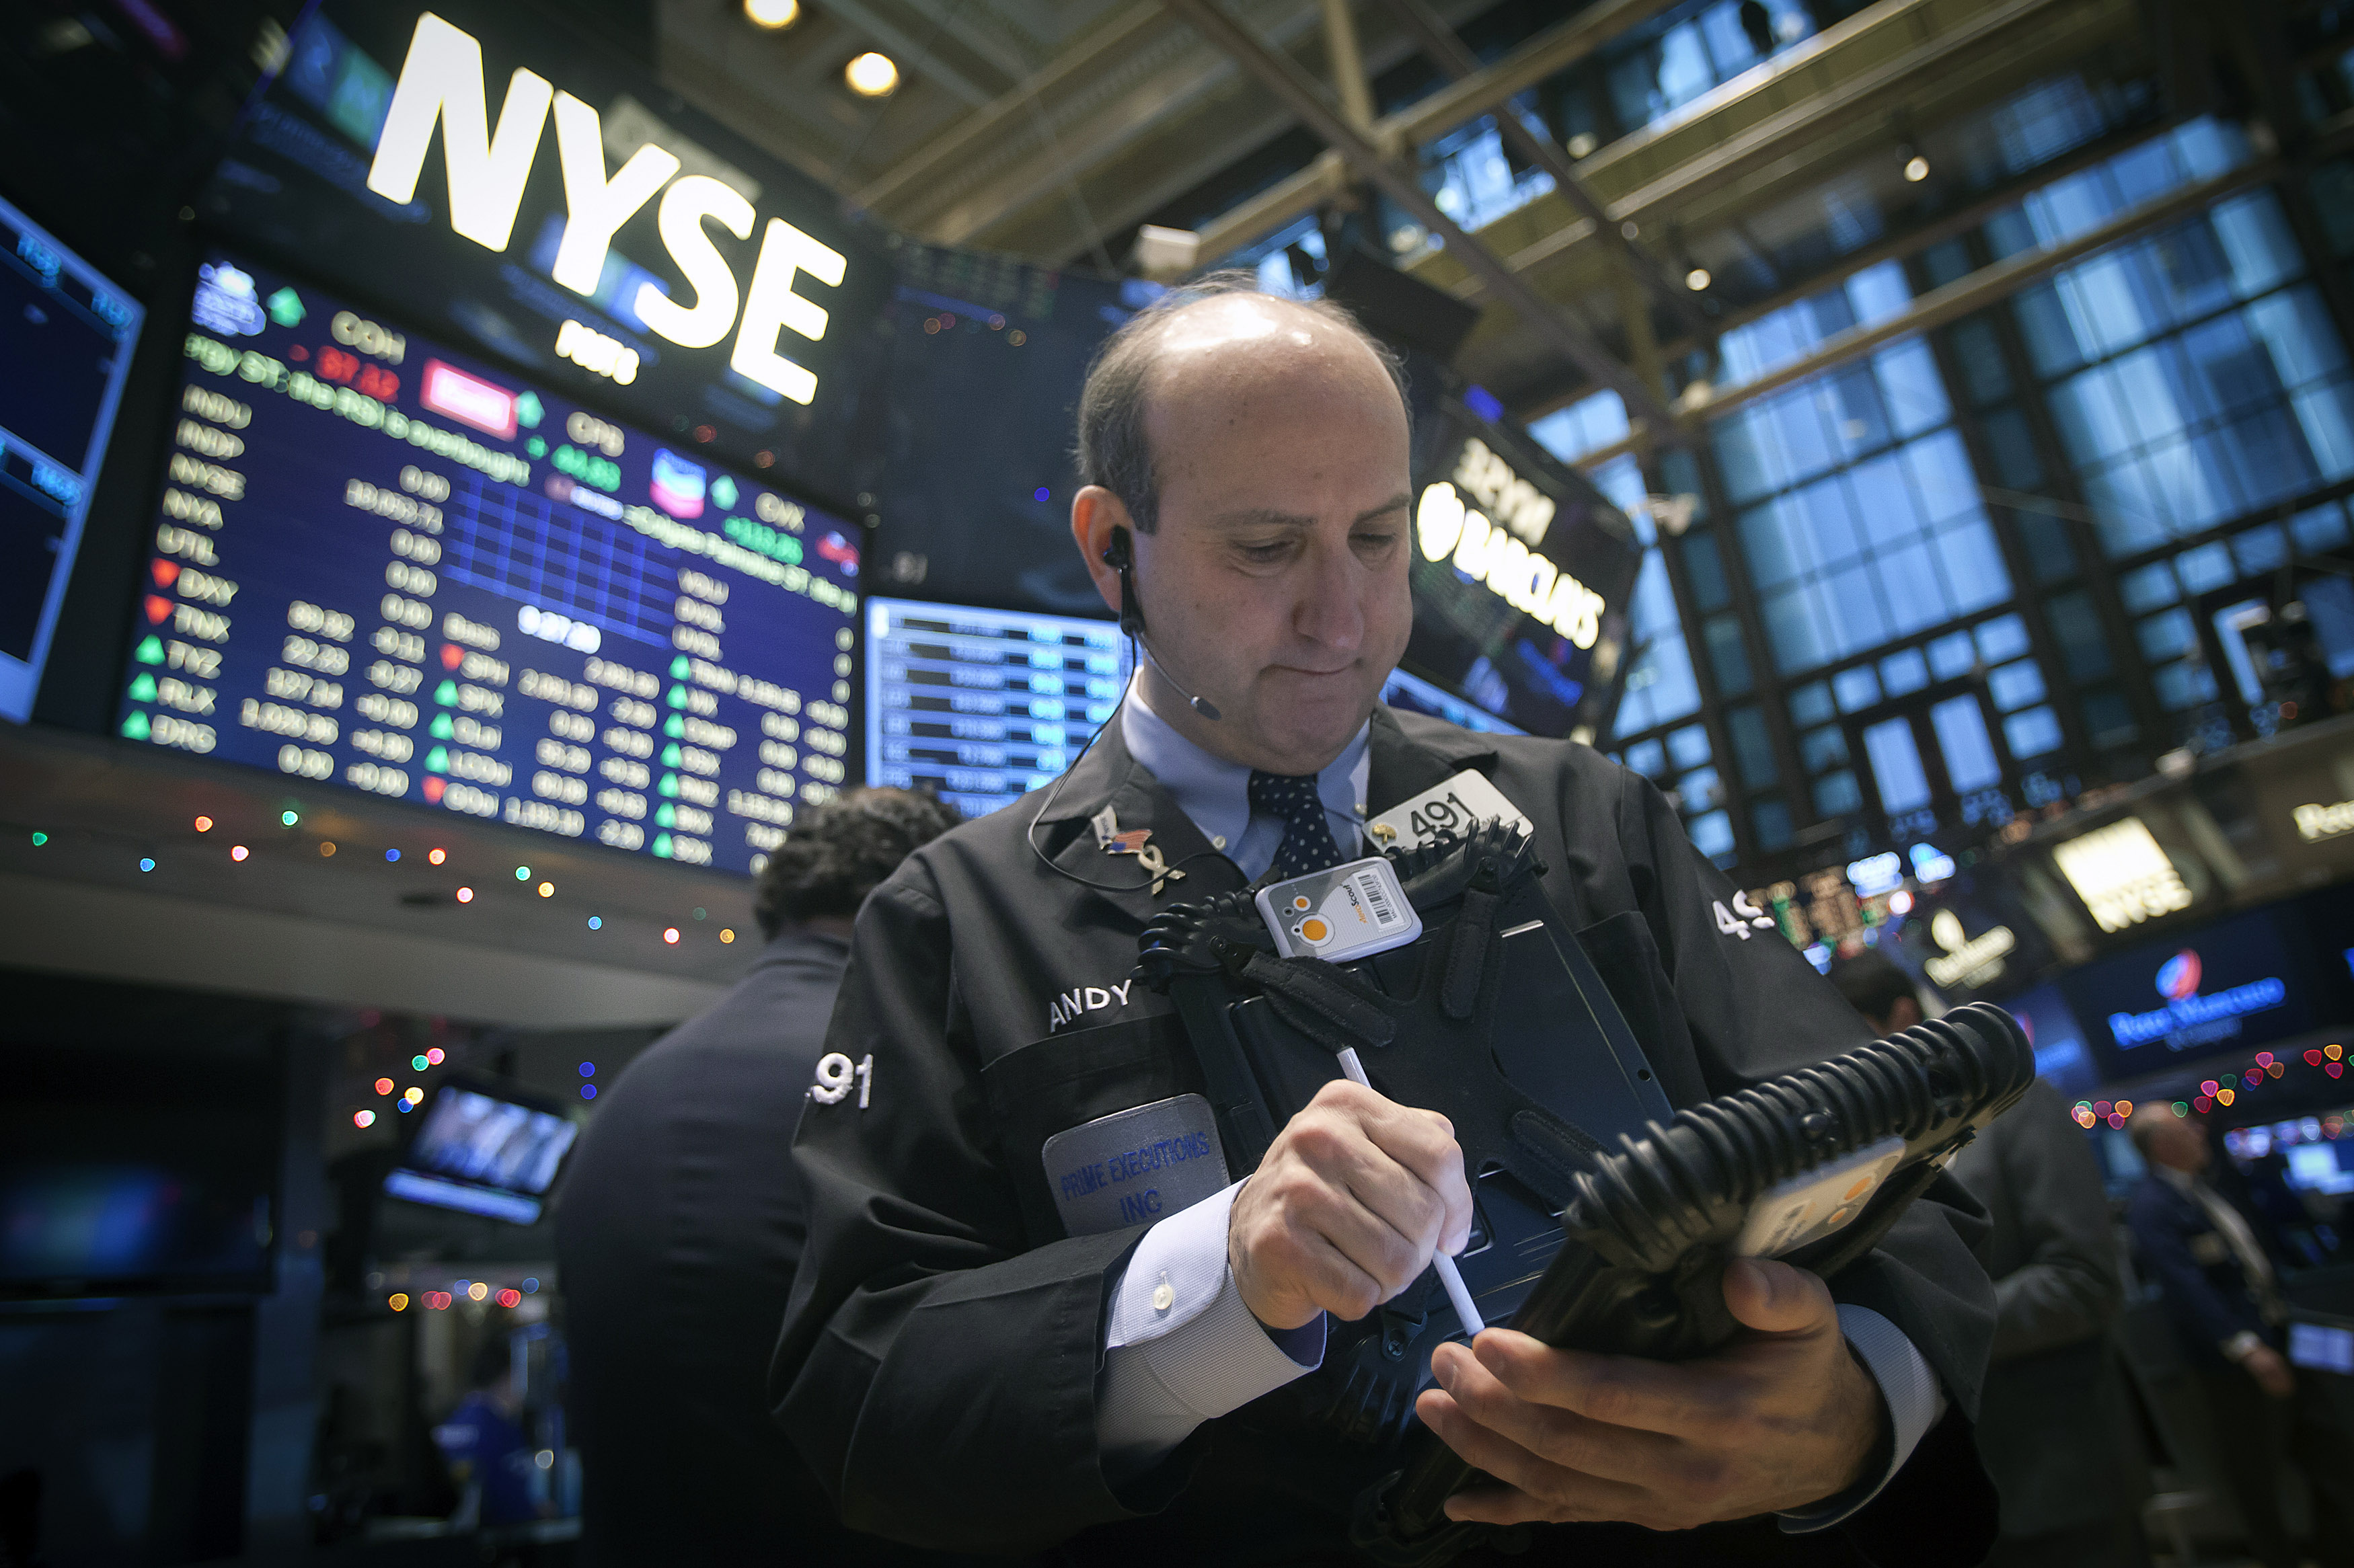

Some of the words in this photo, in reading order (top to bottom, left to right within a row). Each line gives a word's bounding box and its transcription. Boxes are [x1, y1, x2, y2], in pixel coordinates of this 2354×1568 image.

[367, 11, 847, 405] NYSE
[1411, 792, 1475, 836] 491
[1342, 884, 1368, 924] AeroScout
[1050, 979, 1131, 1033] ANDY
[804, 1052, 874, 1109] 91
[1060, 1163, 1108, 1201] PRIME
[1108, 1131, 1210, 1183] EXECUTIONS
[1119, 1189, 1162, 1223] INC
